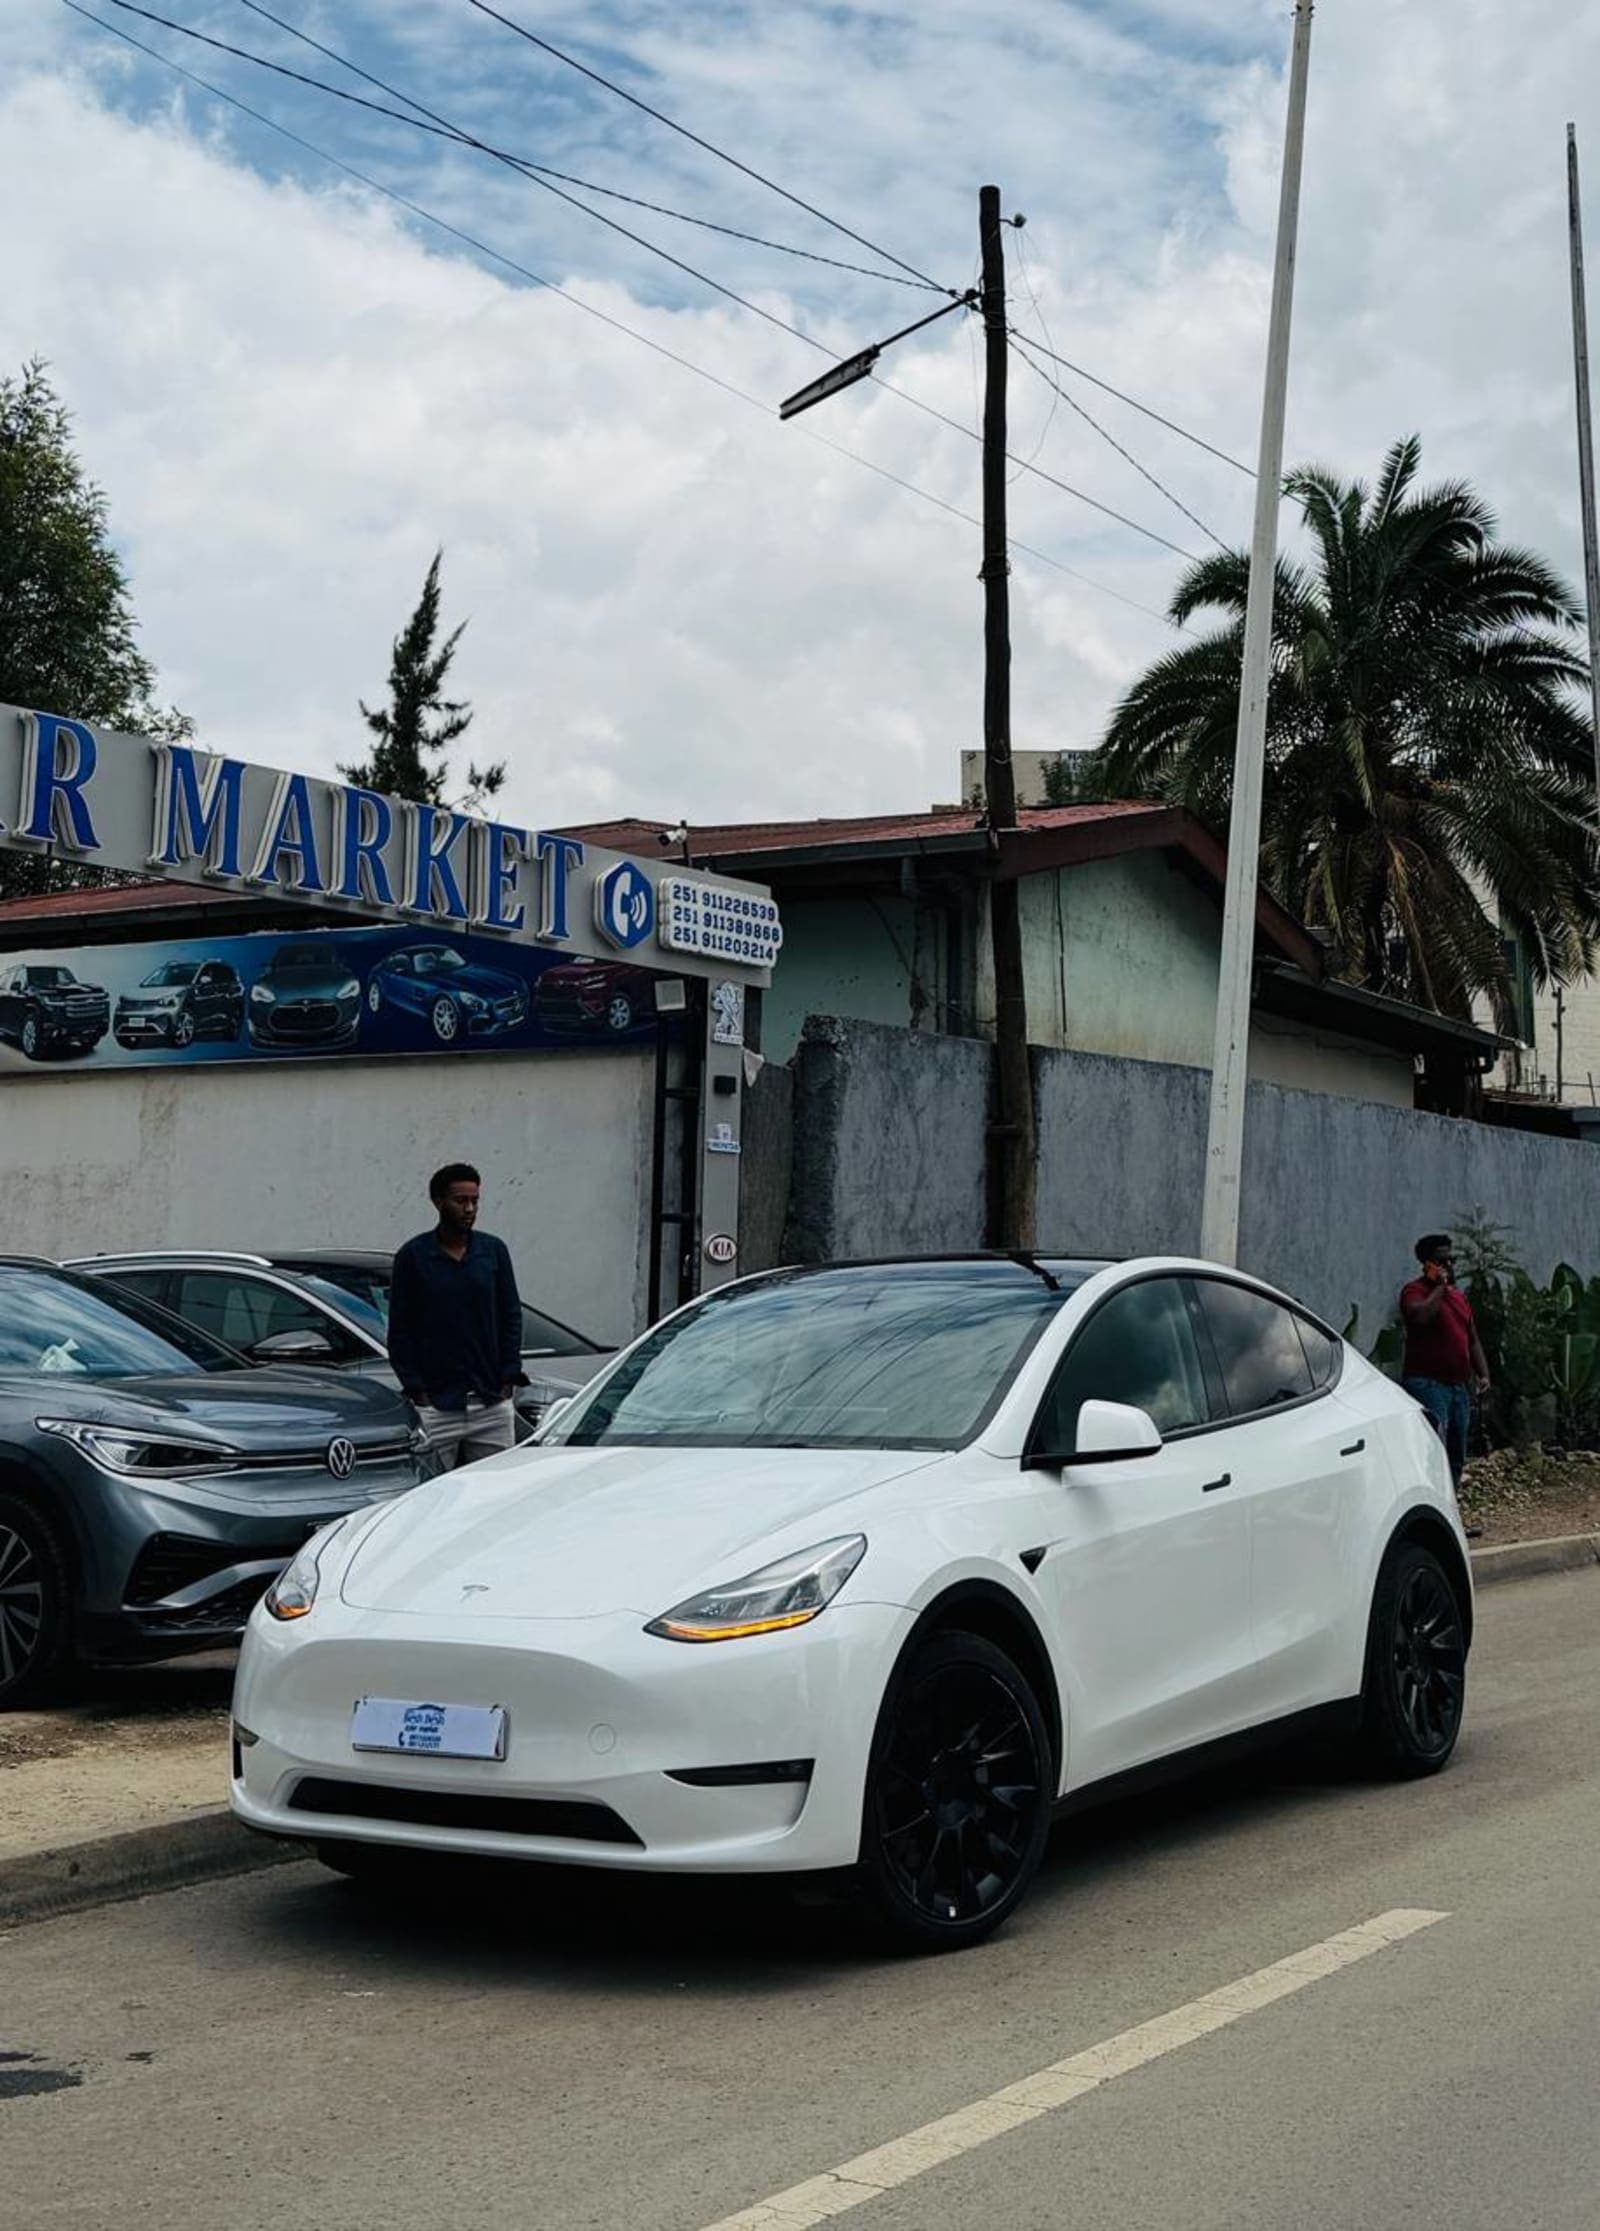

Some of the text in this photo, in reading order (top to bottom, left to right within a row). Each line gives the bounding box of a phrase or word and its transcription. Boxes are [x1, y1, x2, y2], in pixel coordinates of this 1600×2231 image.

[0, 712, 584, 940] R MARKET
[673, 884, 776, 922] 251 911226539
[673, 905, 698, 925] 251
[673, 926, 774, 961] 251 911203214
[712, 1241, 733, 1257] KIA
